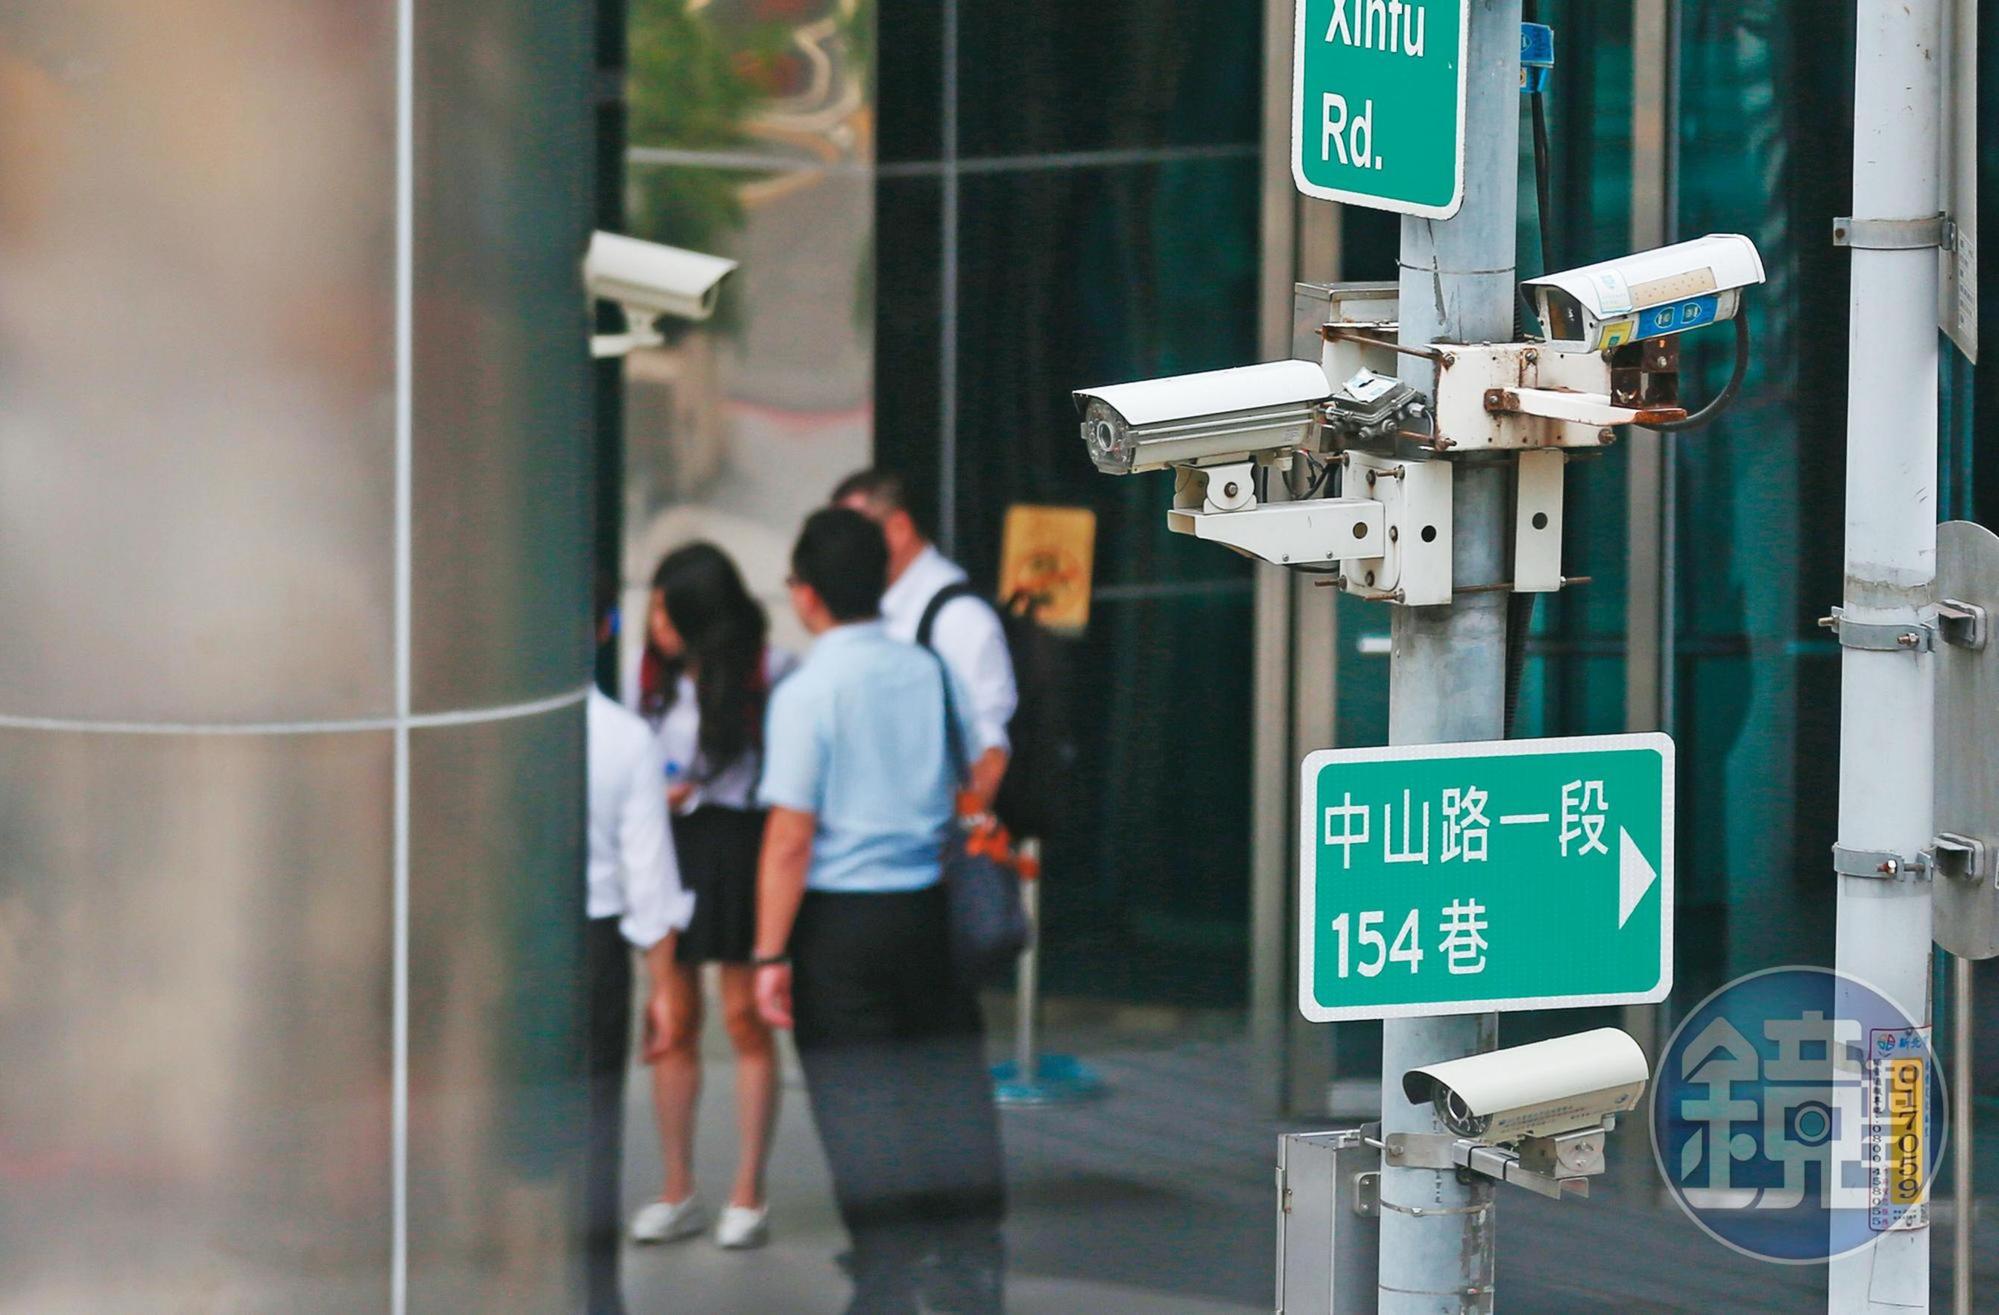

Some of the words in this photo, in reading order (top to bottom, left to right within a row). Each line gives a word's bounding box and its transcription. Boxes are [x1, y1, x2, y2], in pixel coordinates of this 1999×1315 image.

[1322, 92, 1383, 170] Rd.
[1325, 780, 1609, 869] 中山路一段
[1898, 1064, 1920, 1199] 017059
